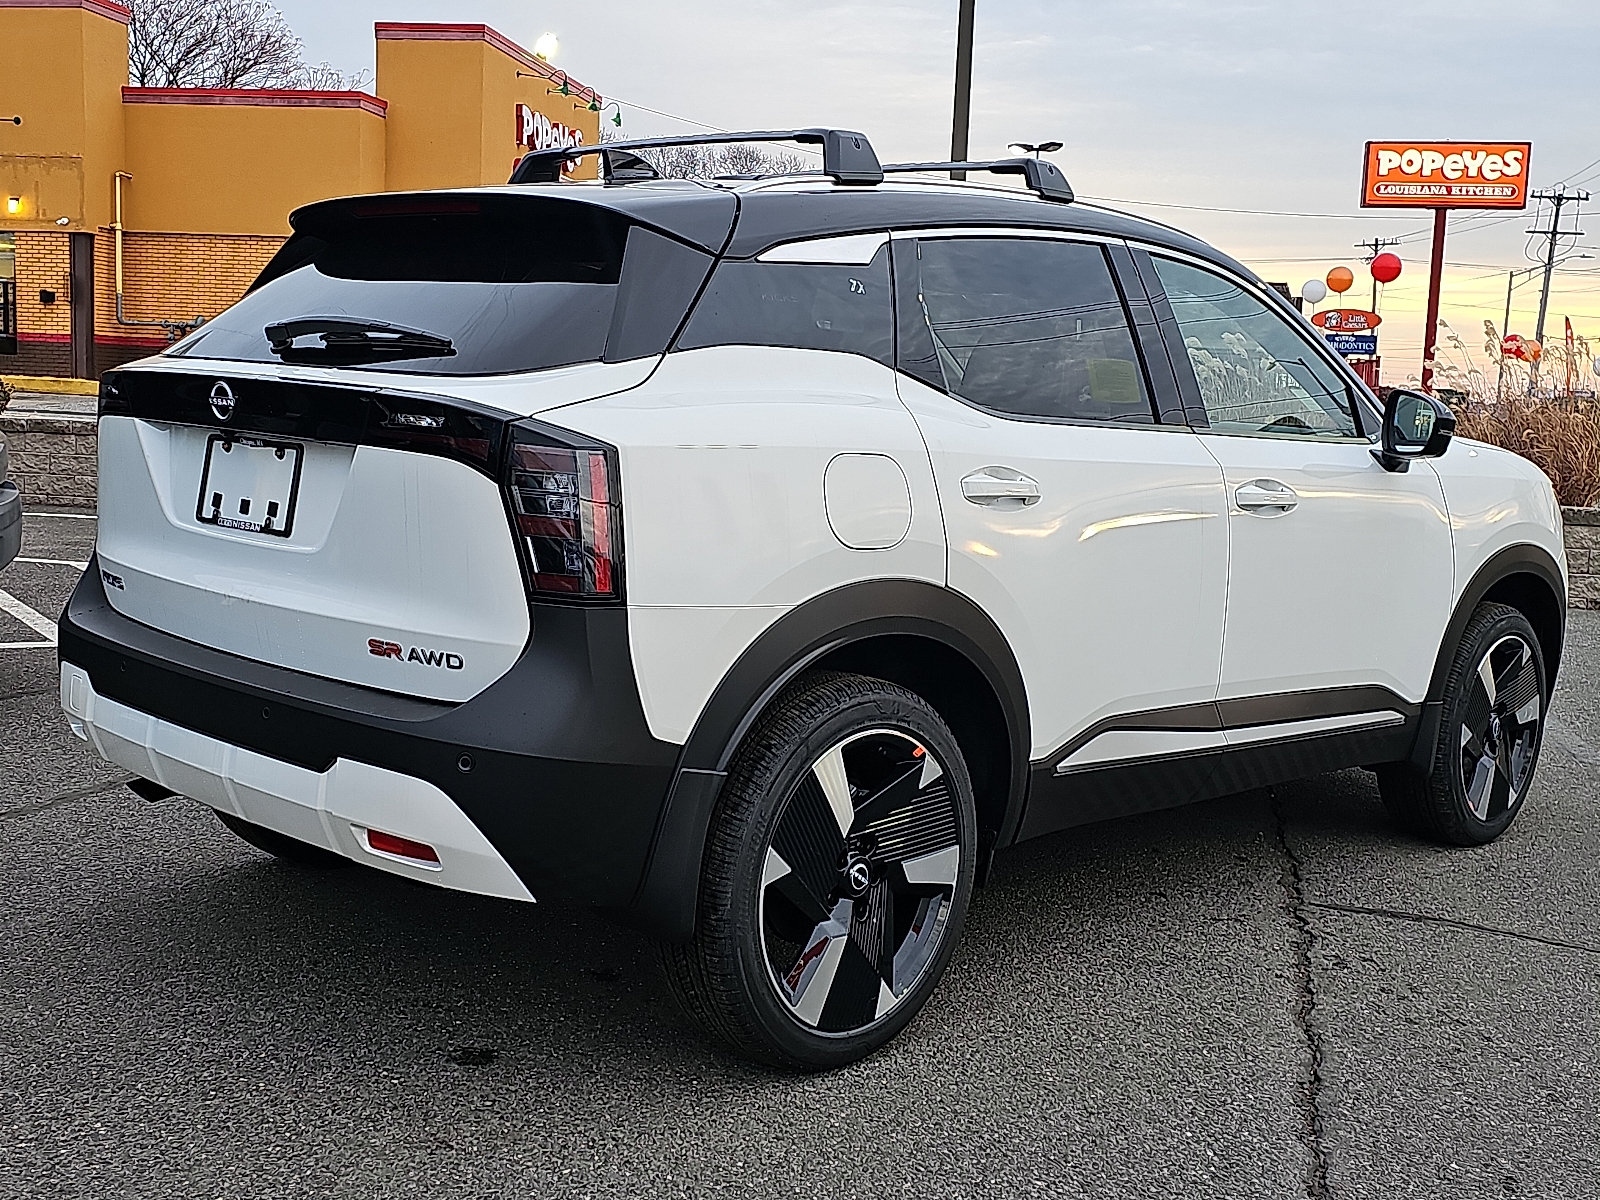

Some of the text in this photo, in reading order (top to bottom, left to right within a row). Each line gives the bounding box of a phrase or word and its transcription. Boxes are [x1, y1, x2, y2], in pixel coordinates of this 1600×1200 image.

[1379, 185, 1513, 196] LOUISIANA KITCHEN
[367, 638, 464, 670] SR AWD
